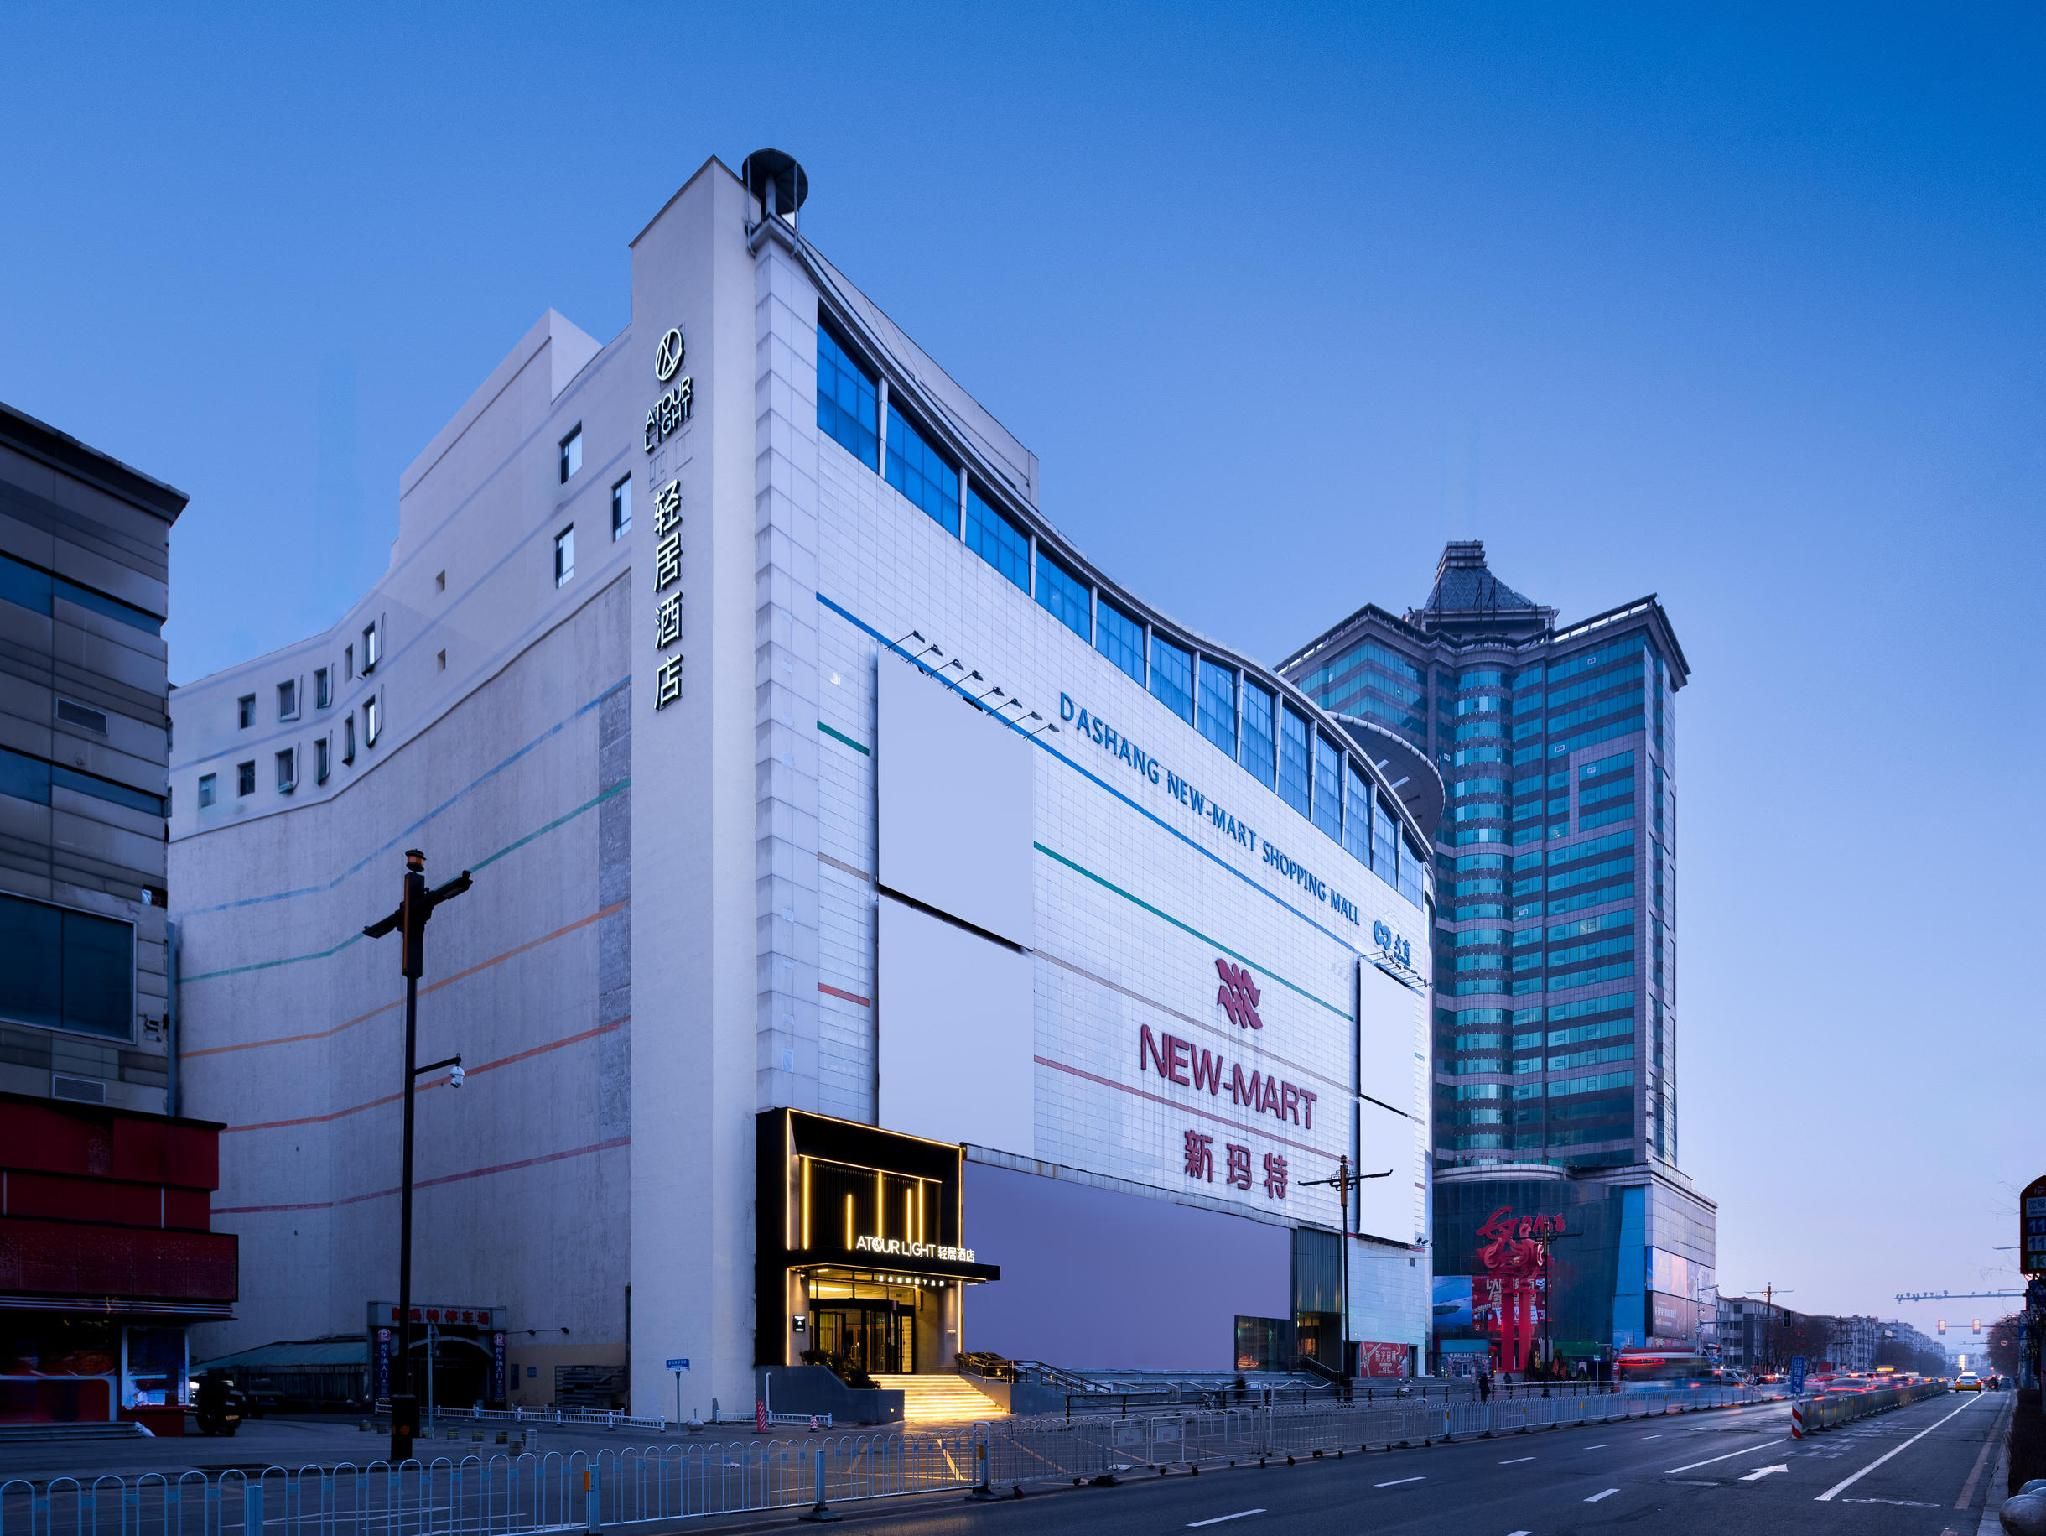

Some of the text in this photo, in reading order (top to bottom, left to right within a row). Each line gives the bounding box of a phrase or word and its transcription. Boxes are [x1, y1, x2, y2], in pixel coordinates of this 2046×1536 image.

[644, 394, 690, 451] LIGHT
[645, 375, 691, 431] ATOUR
[653, 479, 684, 712] 轻居酒店
[1060, 691, 1360, 926] DASHANG NEW-MART SHOPPING MALL
[1140, 1023, 1318, 1130] NEW-MART
[1184, 1129, 1289, 1200] 新玛特
[856, 1235, 936, 1258] ATOUR LIGHT
[937, 1246, 975, 1264] 轻居酒店
